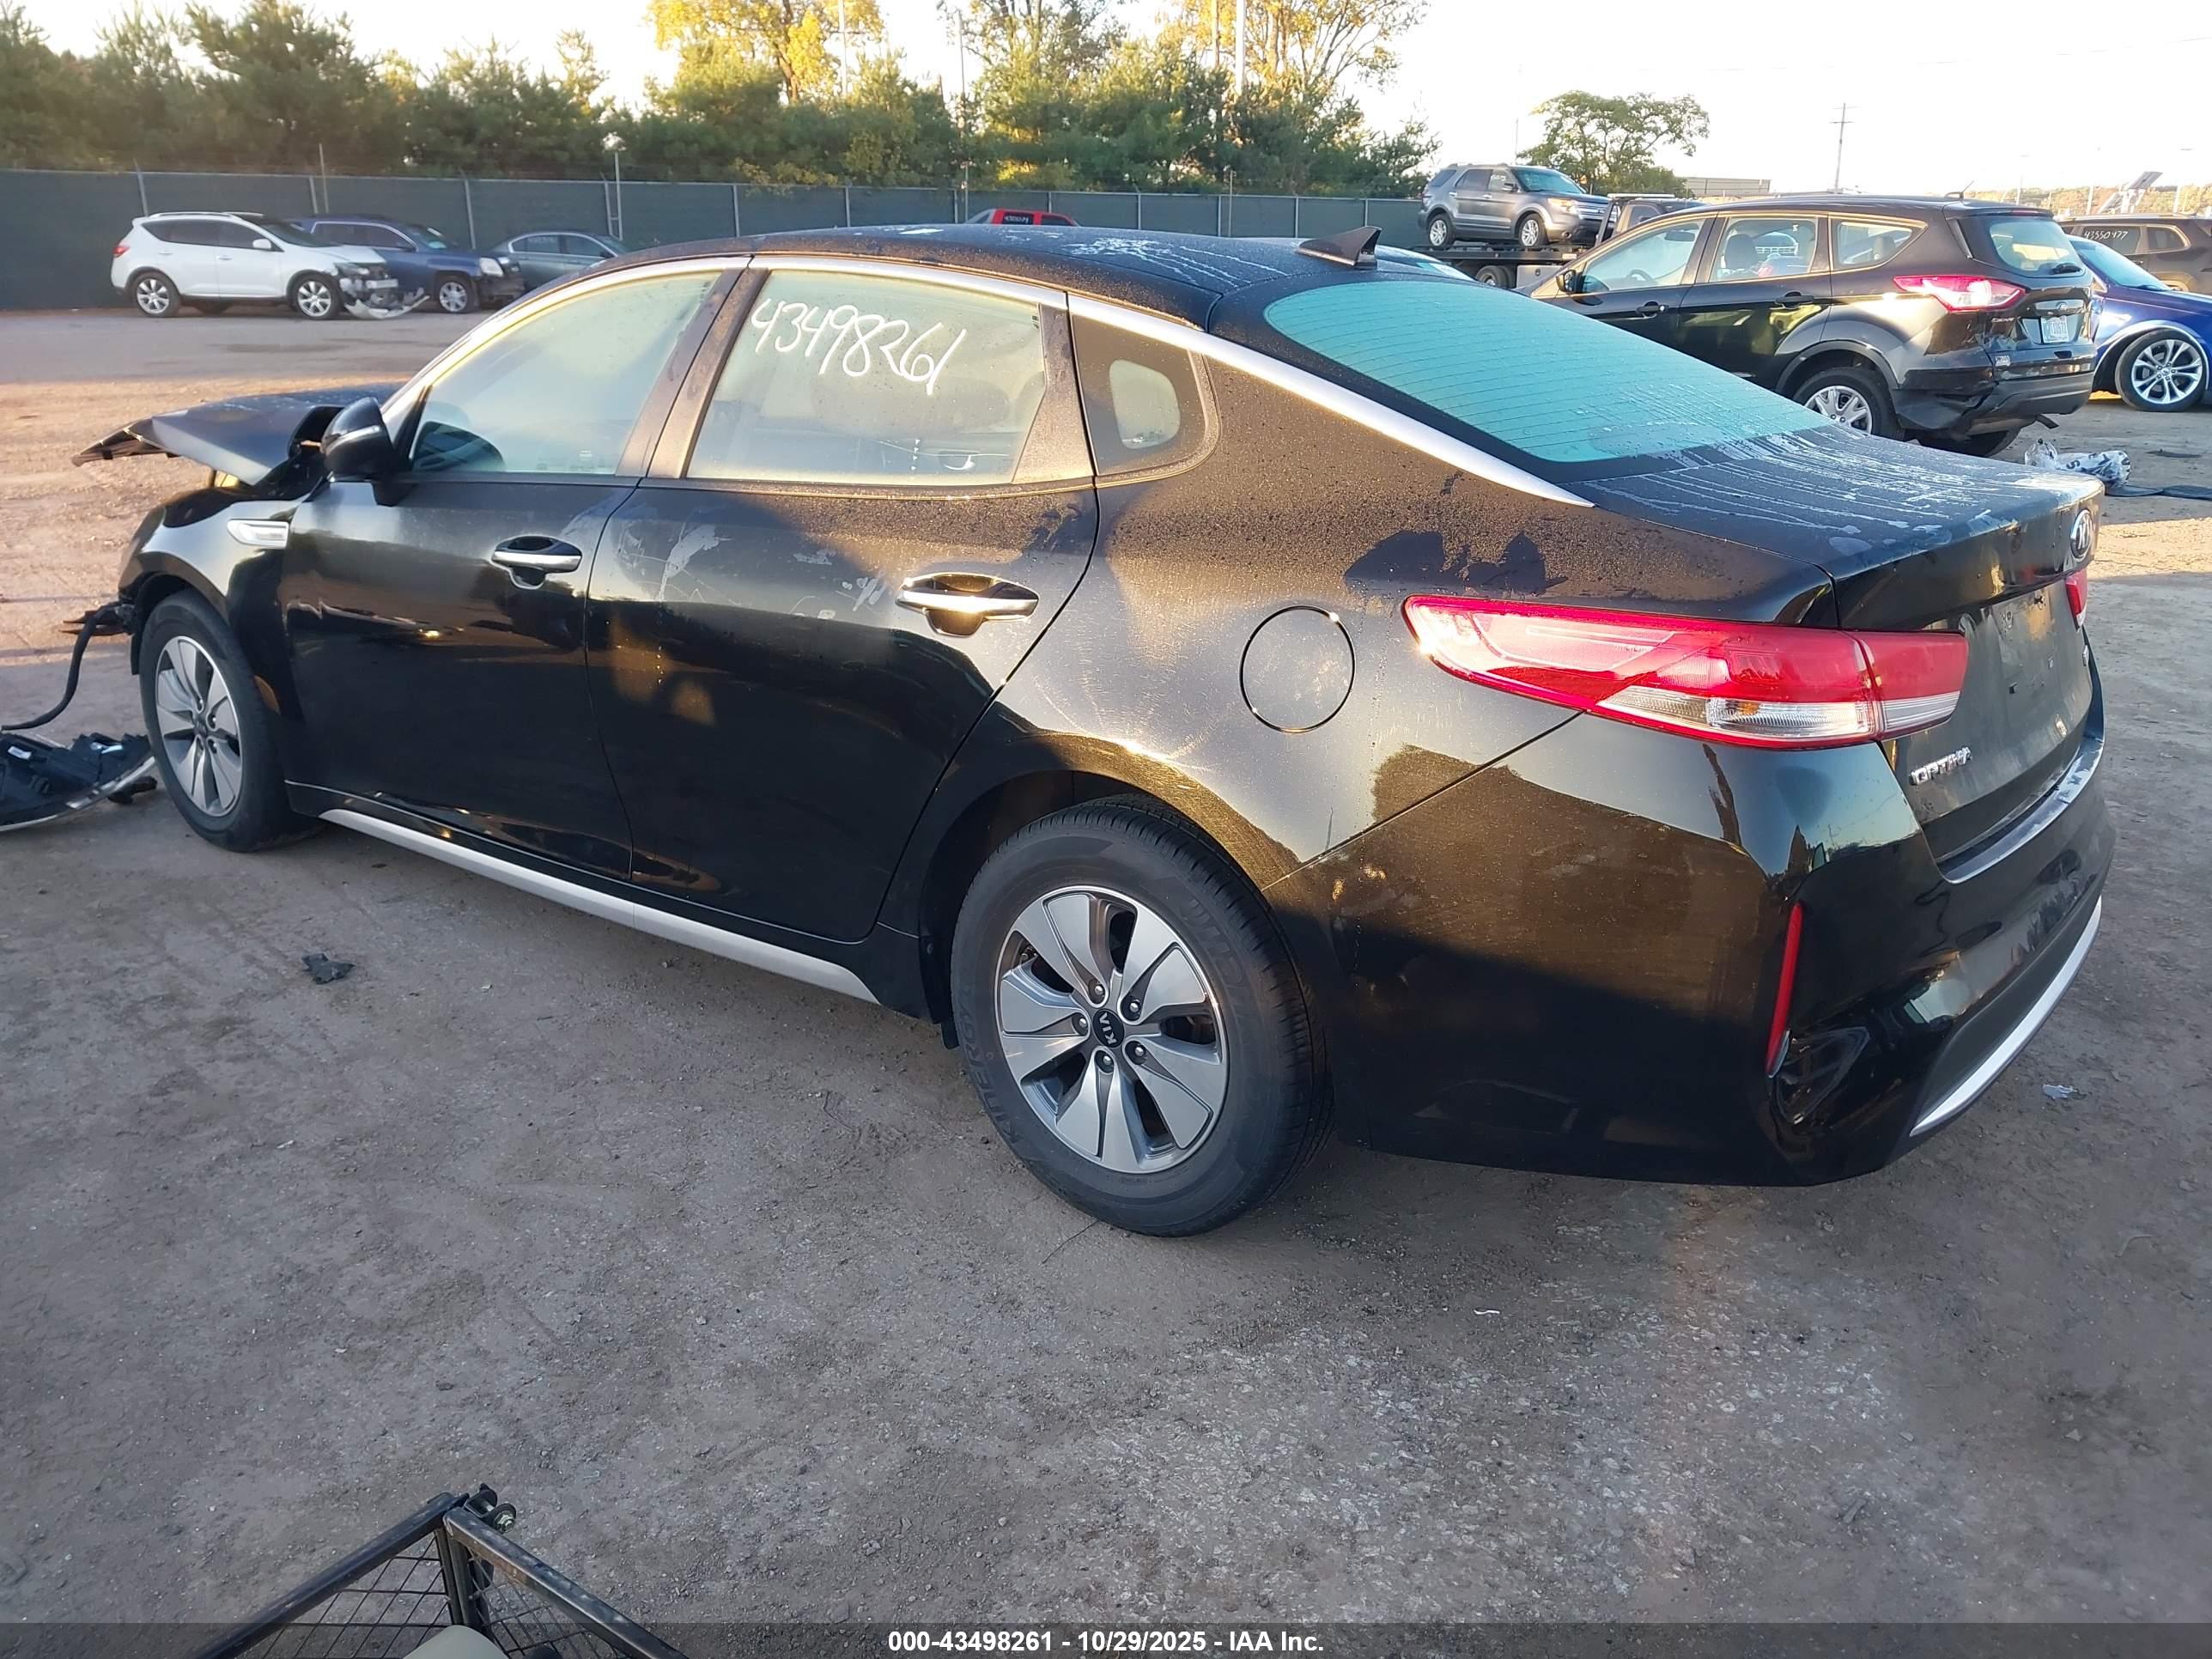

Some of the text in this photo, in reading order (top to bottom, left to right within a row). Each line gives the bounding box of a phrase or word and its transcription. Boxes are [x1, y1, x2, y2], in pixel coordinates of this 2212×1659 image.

[750, 298, 967, 396] 43498261
[1909, 746, 1972, 786] OPTIMA
[1099, 1012, 1117, 1045] KIA
